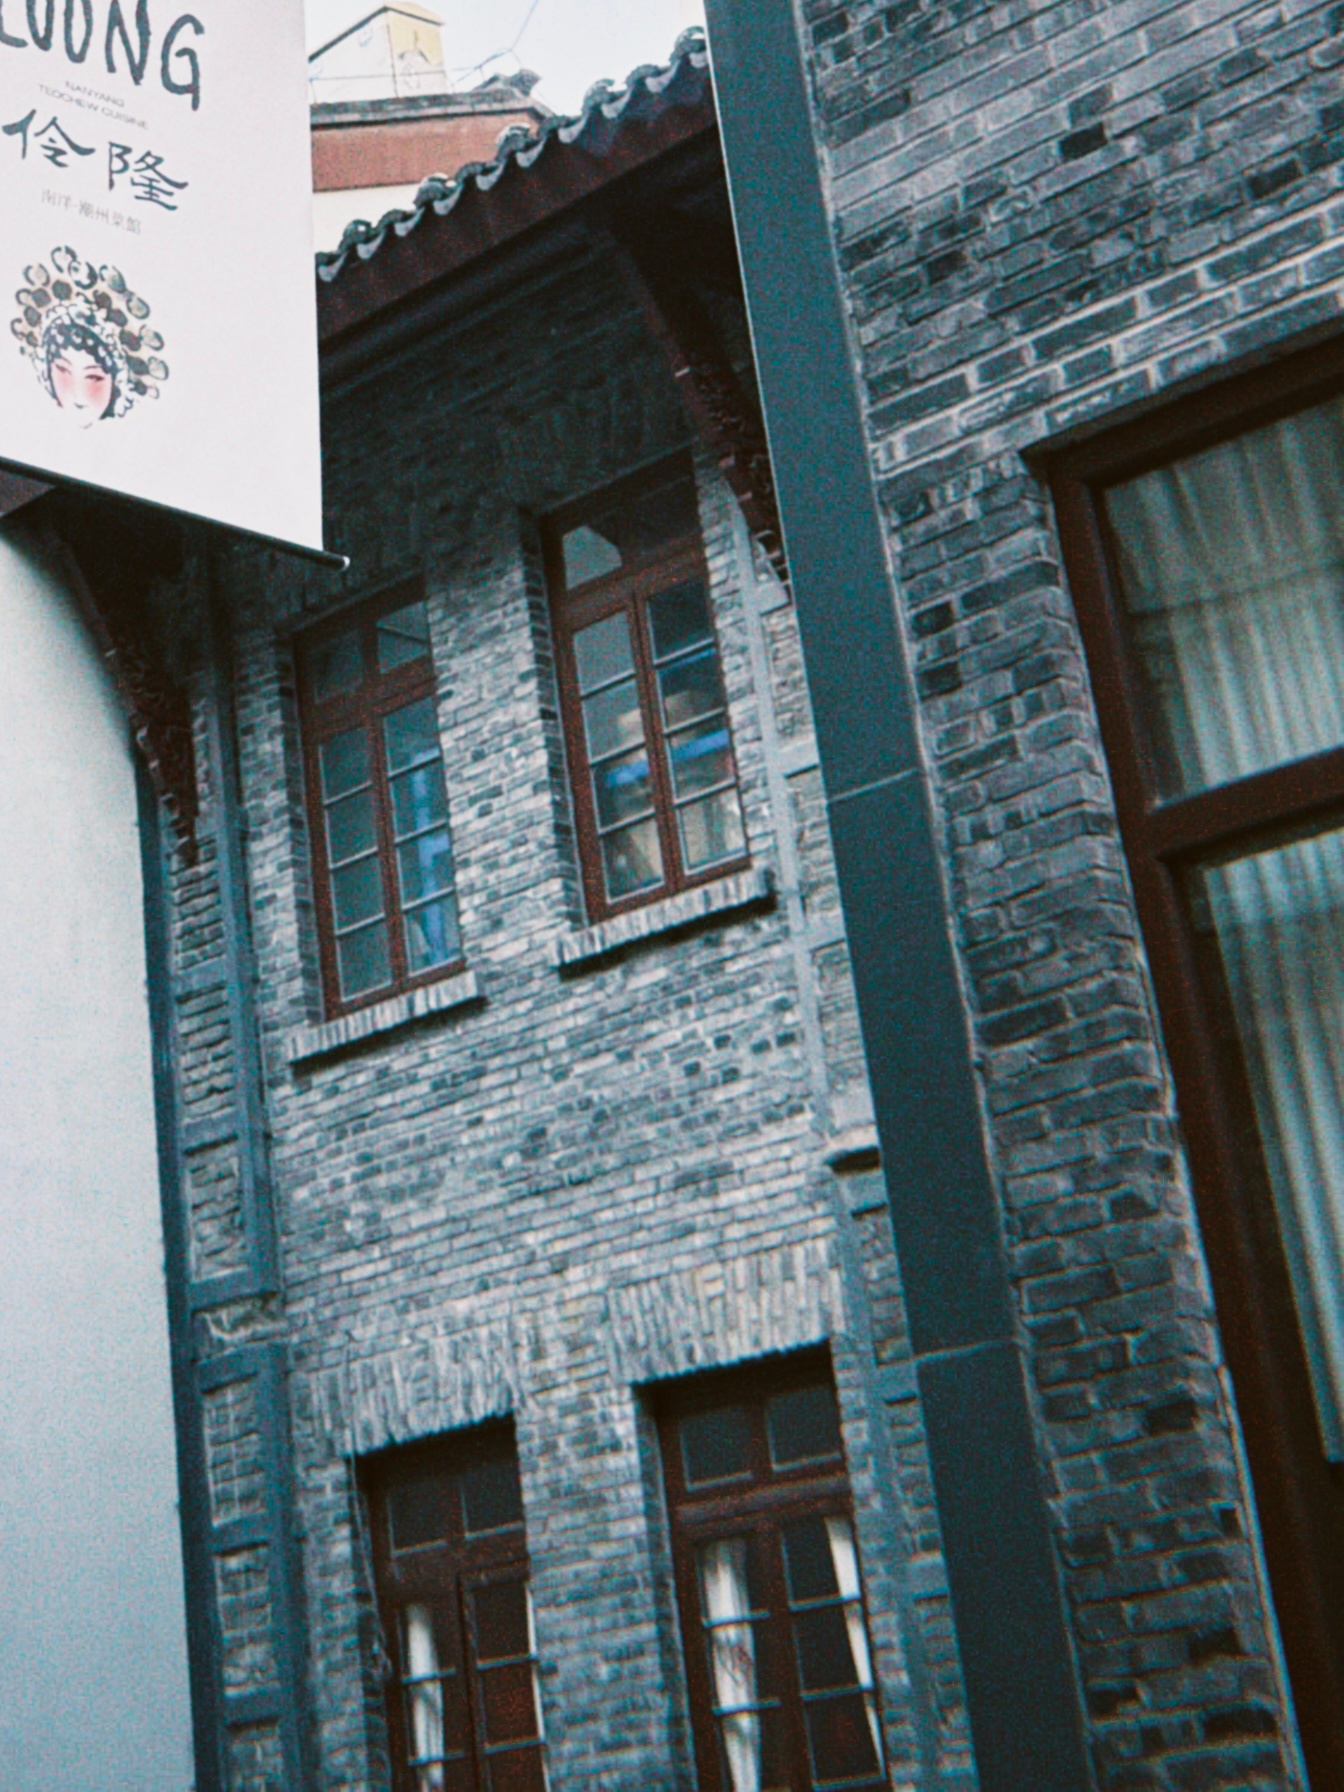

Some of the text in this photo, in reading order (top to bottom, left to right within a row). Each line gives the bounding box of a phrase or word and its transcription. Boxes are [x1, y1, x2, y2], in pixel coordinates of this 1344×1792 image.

[38, 83, 149, 130] TEOCHEW CUISINE
[64, 80, 125, 108] NANYANG
